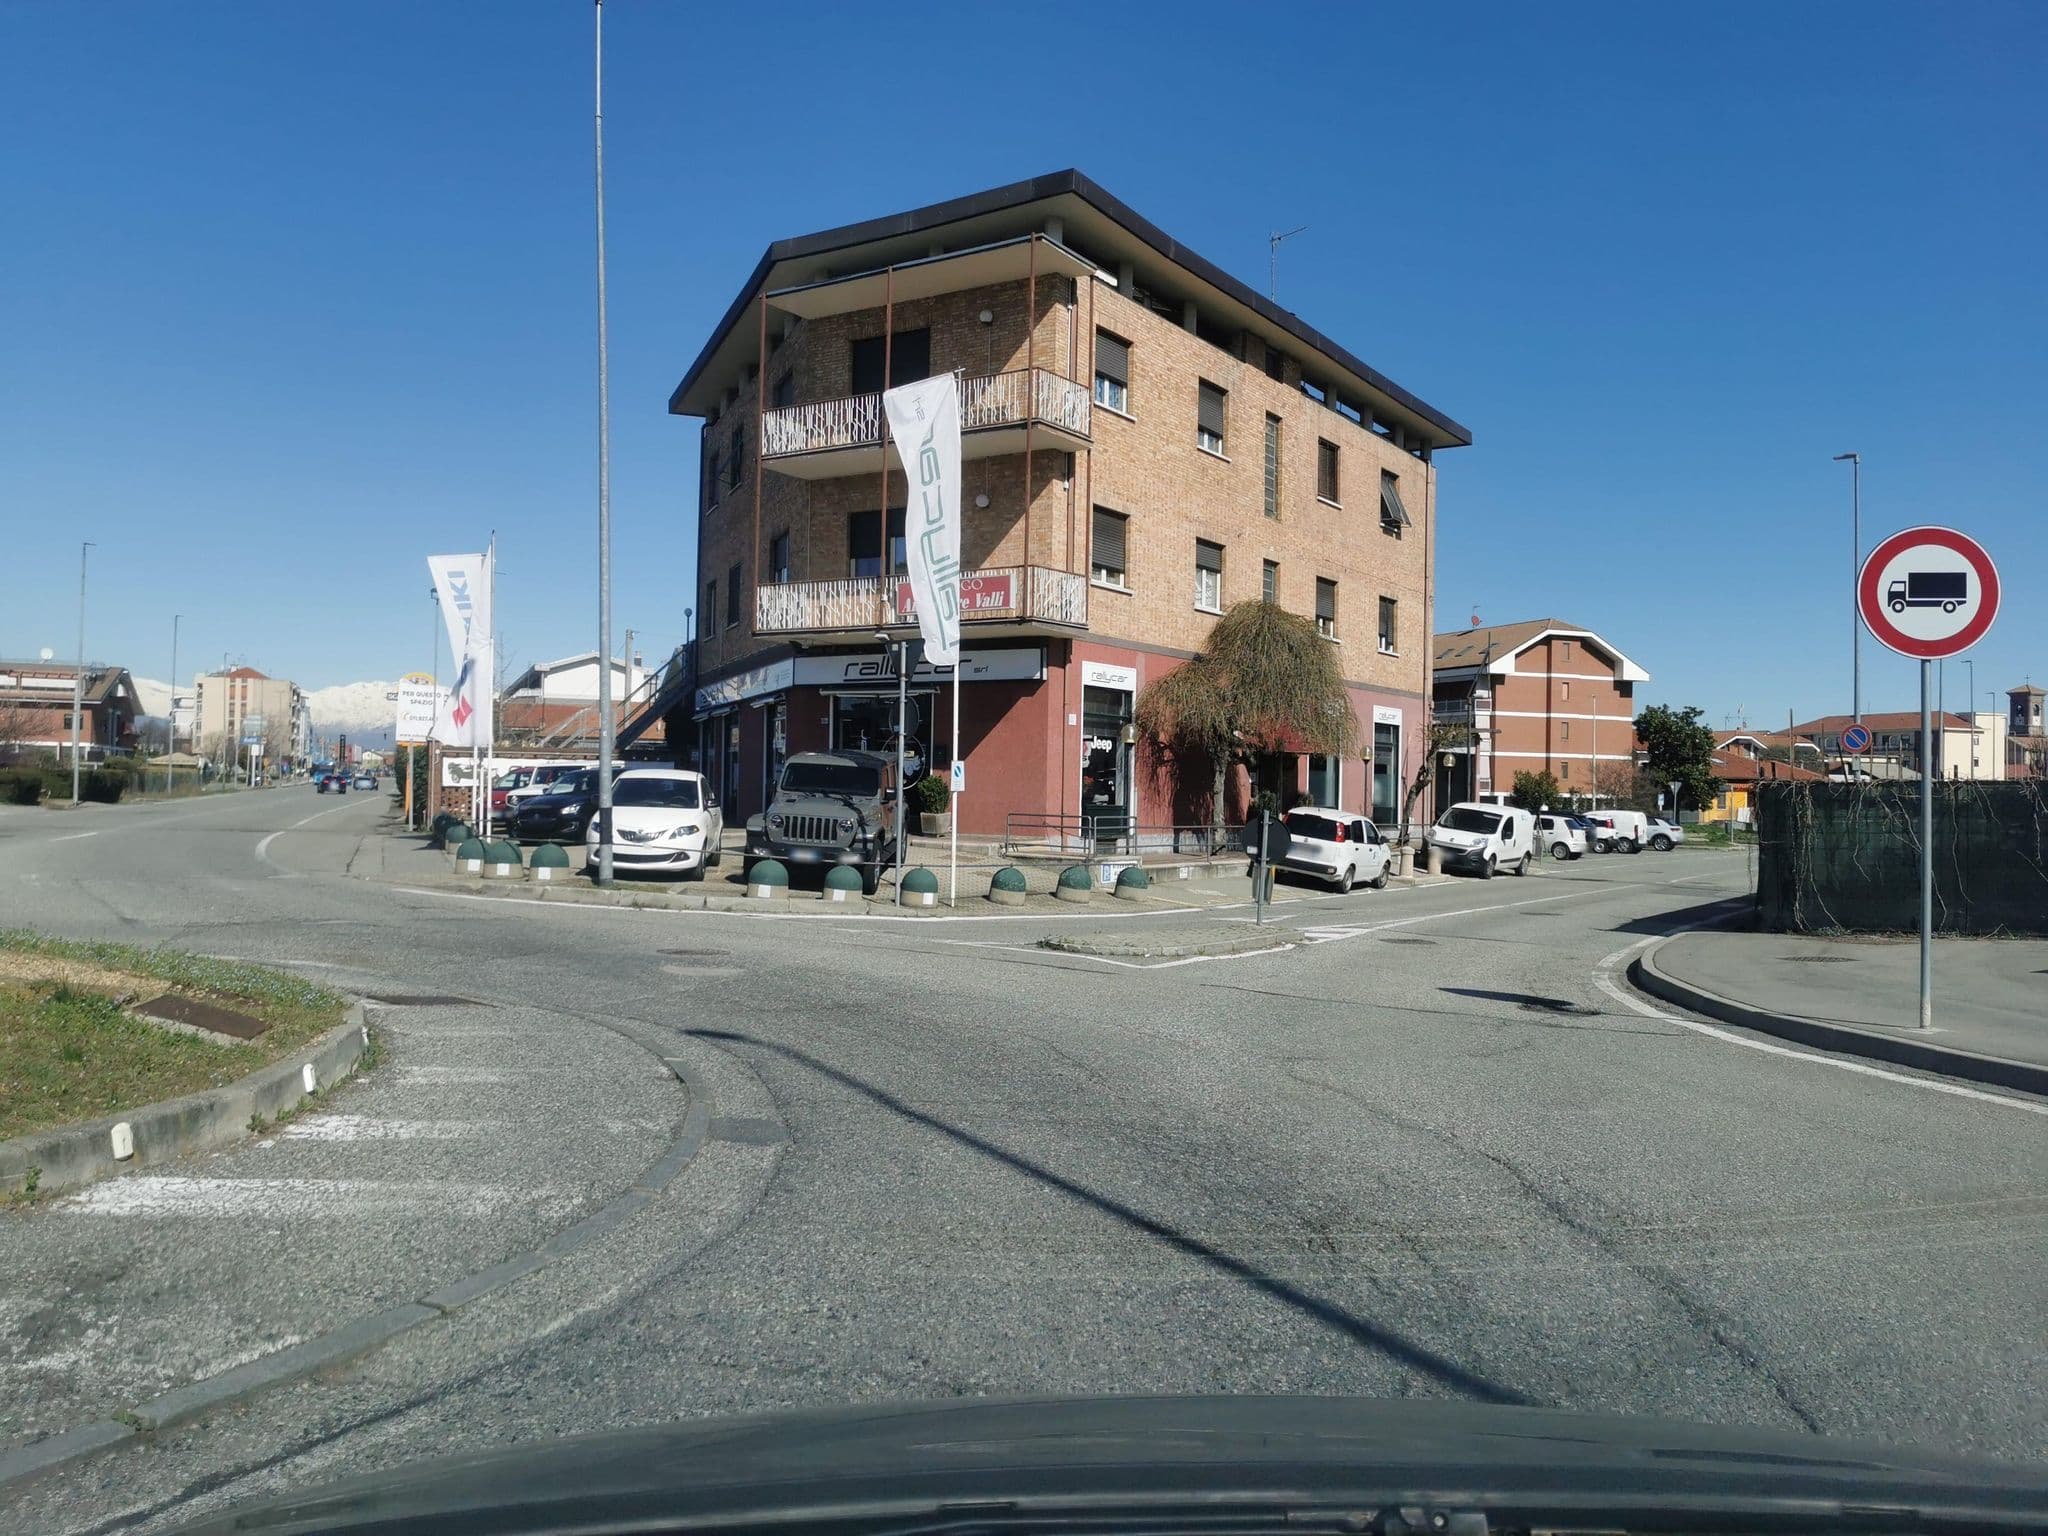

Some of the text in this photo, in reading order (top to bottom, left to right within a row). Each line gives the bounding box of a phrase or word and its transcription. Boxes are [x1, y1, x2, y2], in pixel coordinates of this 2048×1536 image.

[975, 591, 1005, 608] Valli
[843, 655, 972, 682] rallcar
[1090, 671, 1128, 683] rallycar
[1090, 735, 1113, 753] Jeep
